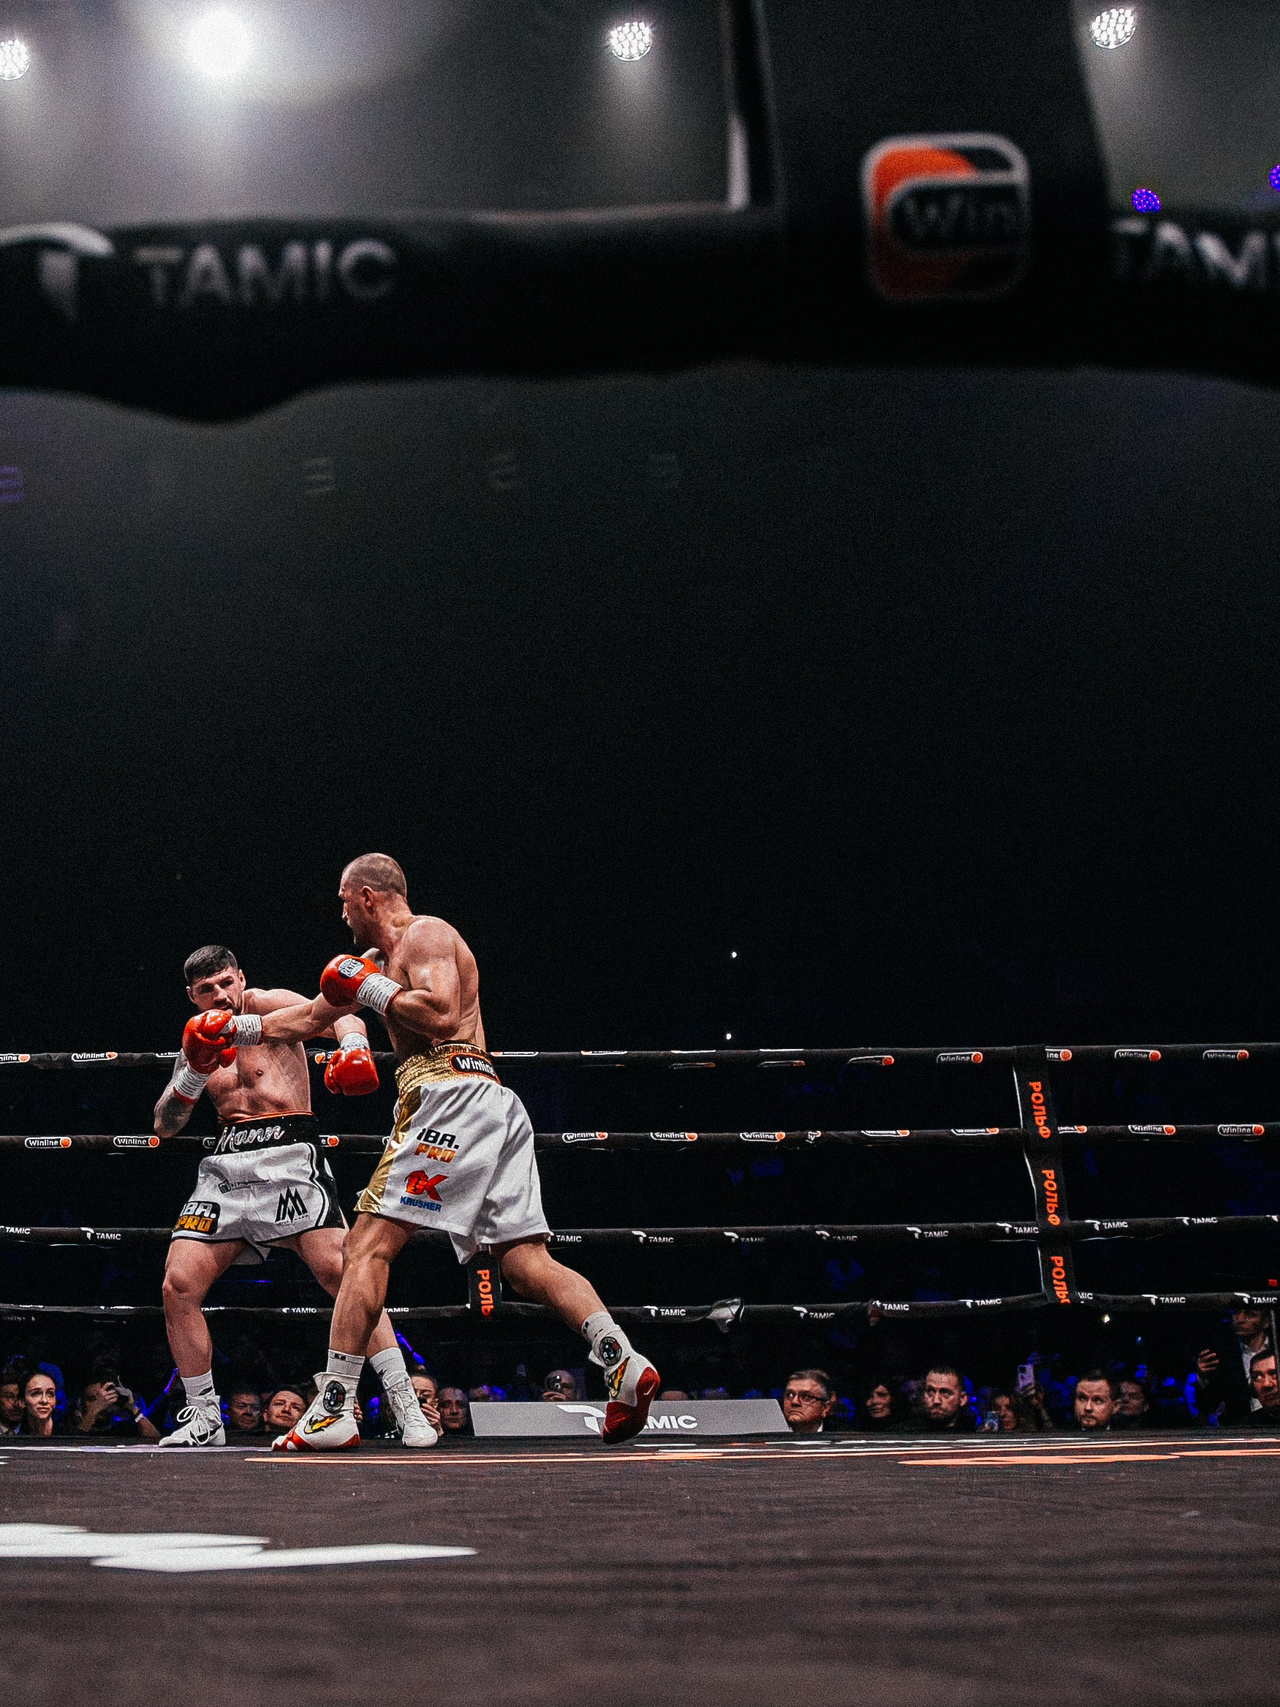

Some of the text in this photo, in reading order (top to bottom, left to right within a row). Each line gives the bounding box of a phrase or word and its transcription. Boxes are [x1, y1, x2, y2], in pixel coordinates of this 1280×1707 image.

[135, 238, 398, 309] TAMIC
[1029, 1080, 1052, 1140] РОЛЬФ
[1222, 1126, 1252, 1134] Winline
[28, 1138, 59, 1148] Winline
[117, 1137, 147, 1146] Winline
[414, 1142, 456, 1163] PRO
[1041, 1168, 1062, 1227] РОЛЬФ
[400, 1195, 442, 1212] KRUSHER
[174, 1215, 213, 1232] PRO
[1102, 1221, 1129, 1229] TAMIC
[5, 1226, 31, 1235] TAMIC
[1014, 1226, 1040, 1234] TAMIC
[95, 1232, 122, 1241] TAMIC
[556, 1234, 582, 1242] TAMIC
[476, 1269, 495, 1318] РОЛЬ
[1159, 1296, 1186, 1304] TAMIC
[1252, 1296, 1278, 1304] TAMIC
[643, 1414, 699, 1430] MIC
